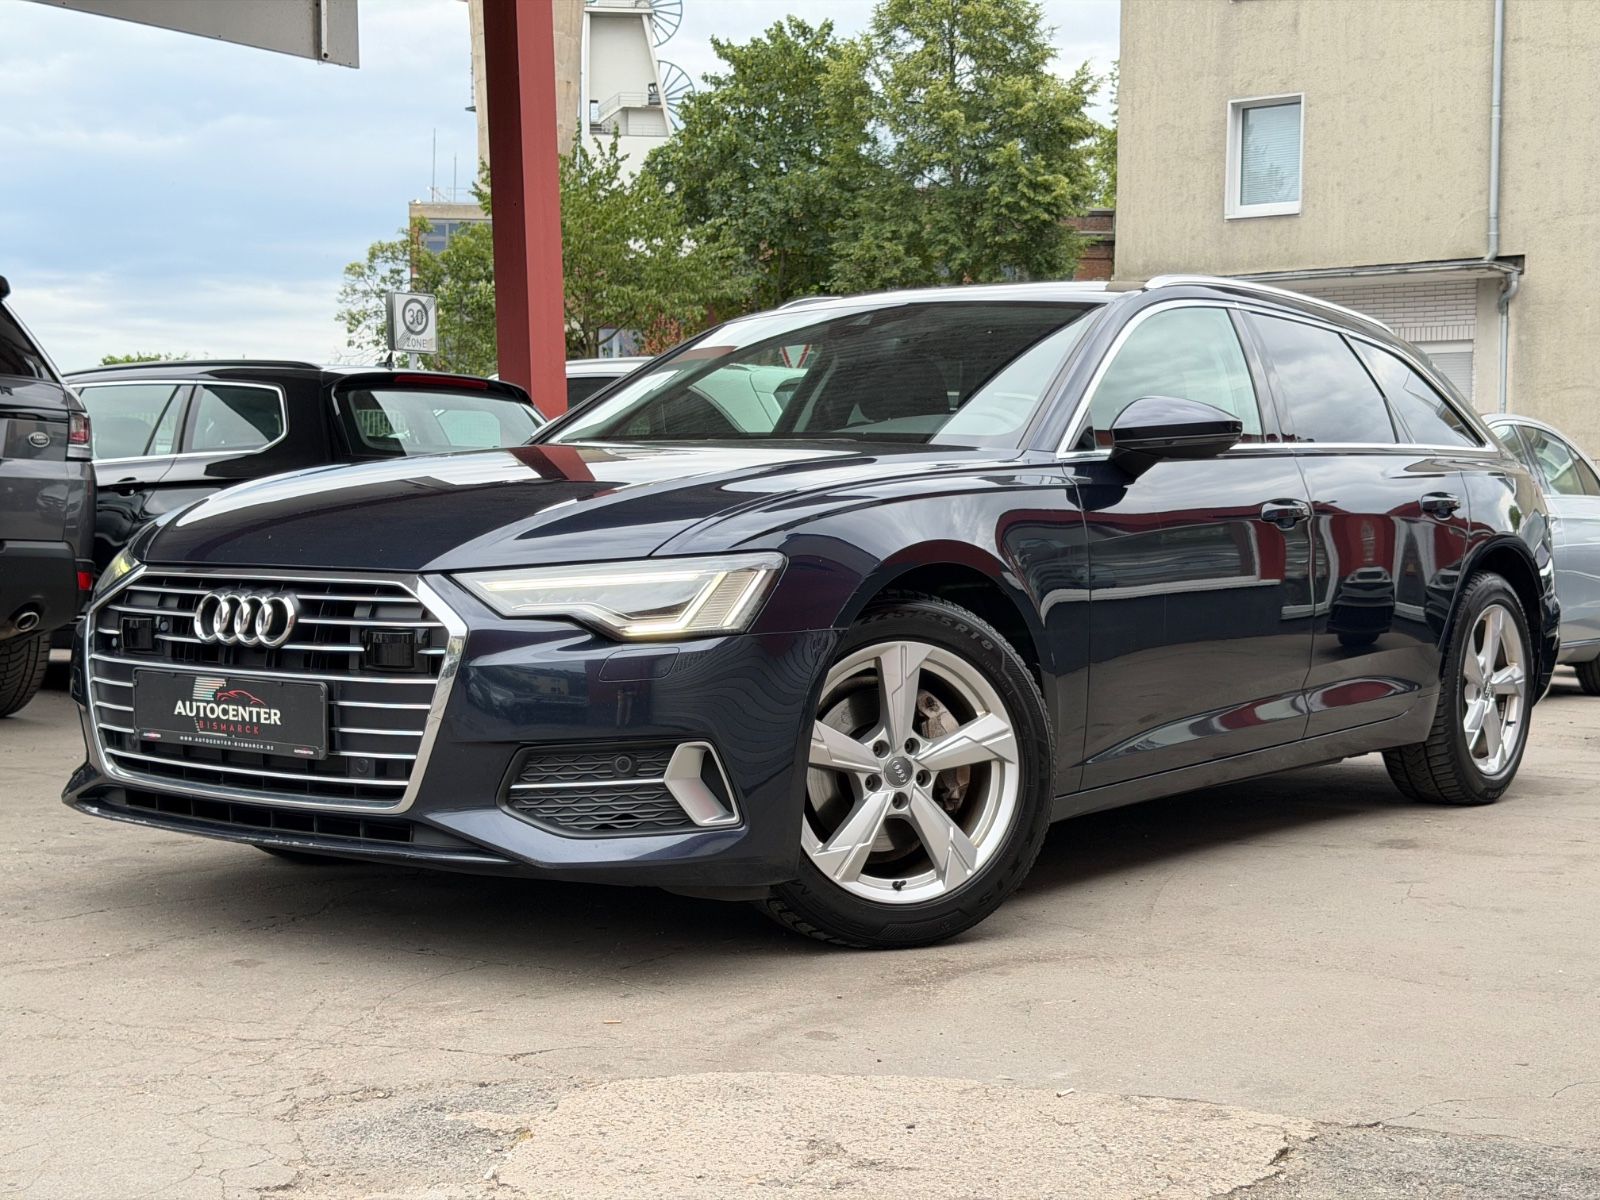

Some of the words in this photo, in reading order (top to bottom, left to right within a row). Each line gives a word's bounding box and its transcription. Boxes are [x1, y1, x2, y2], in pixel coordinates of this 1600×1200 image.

[407, 308, 424, 326] 30
[406, 336, 427, 349] ZONE
[173, 699, 282, 726] AUTOCENTER
[198, 720, 261, 735] BISMARCK
